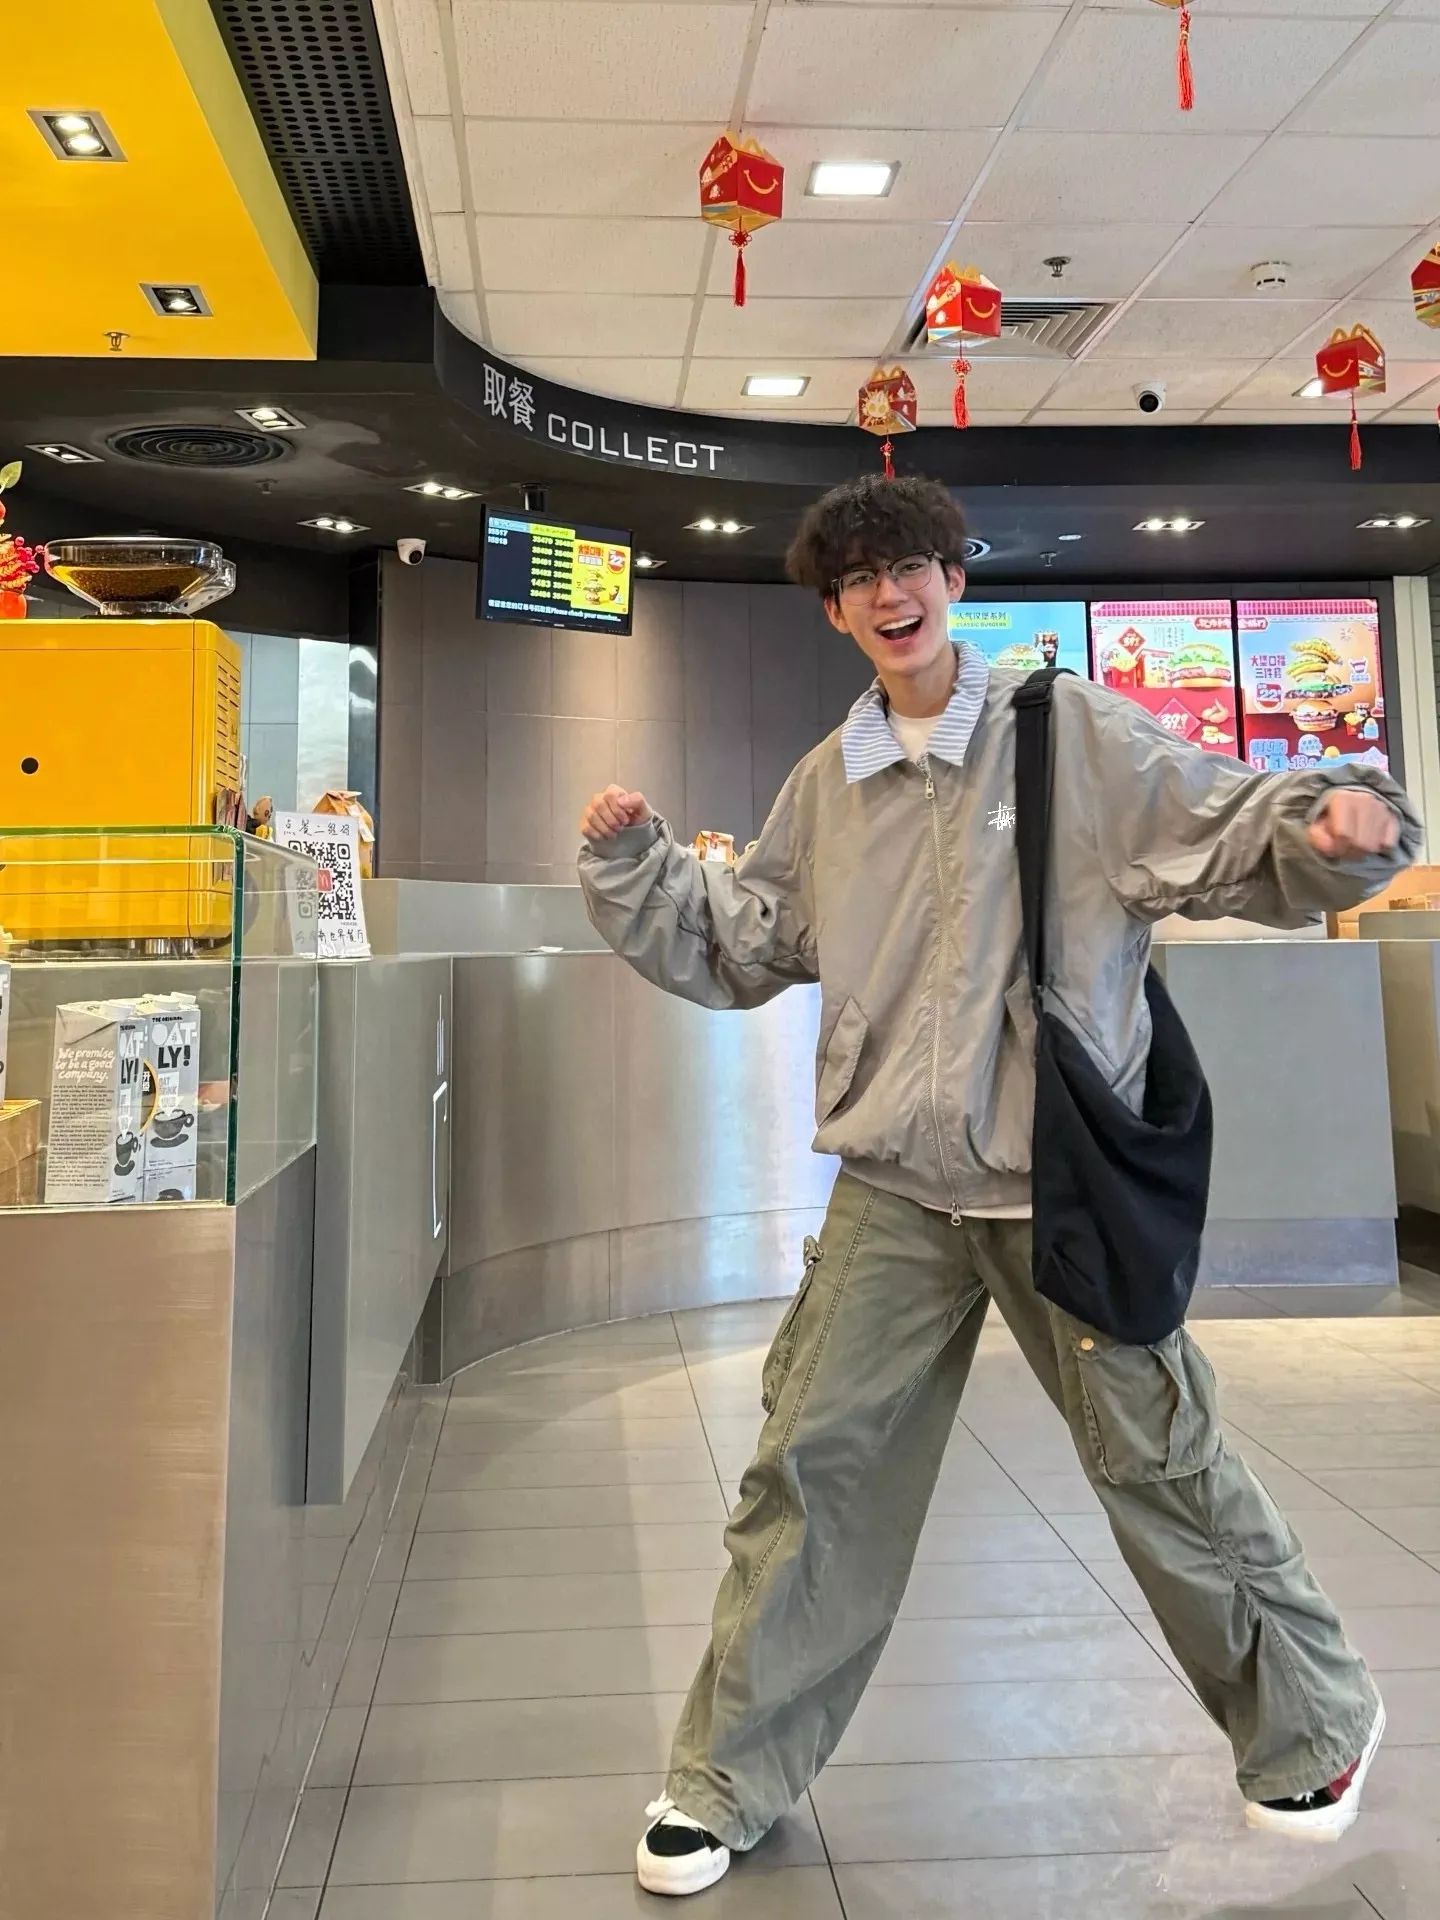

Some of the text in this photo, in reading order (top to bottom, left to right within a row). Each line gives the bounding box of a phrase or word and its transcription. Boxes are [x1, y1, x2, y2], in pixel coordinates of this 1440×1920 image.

[483, 362, 724, 471] 取餐 COLLECT
[55, 1056, 116, 1072] to be a good
[58, 1047, 115, 1061] We promise
[158, 1045, 191, 1069] LY!
[58, 1070, 109, 1084] company.
[121, 1058, 139, 1084] LY!
